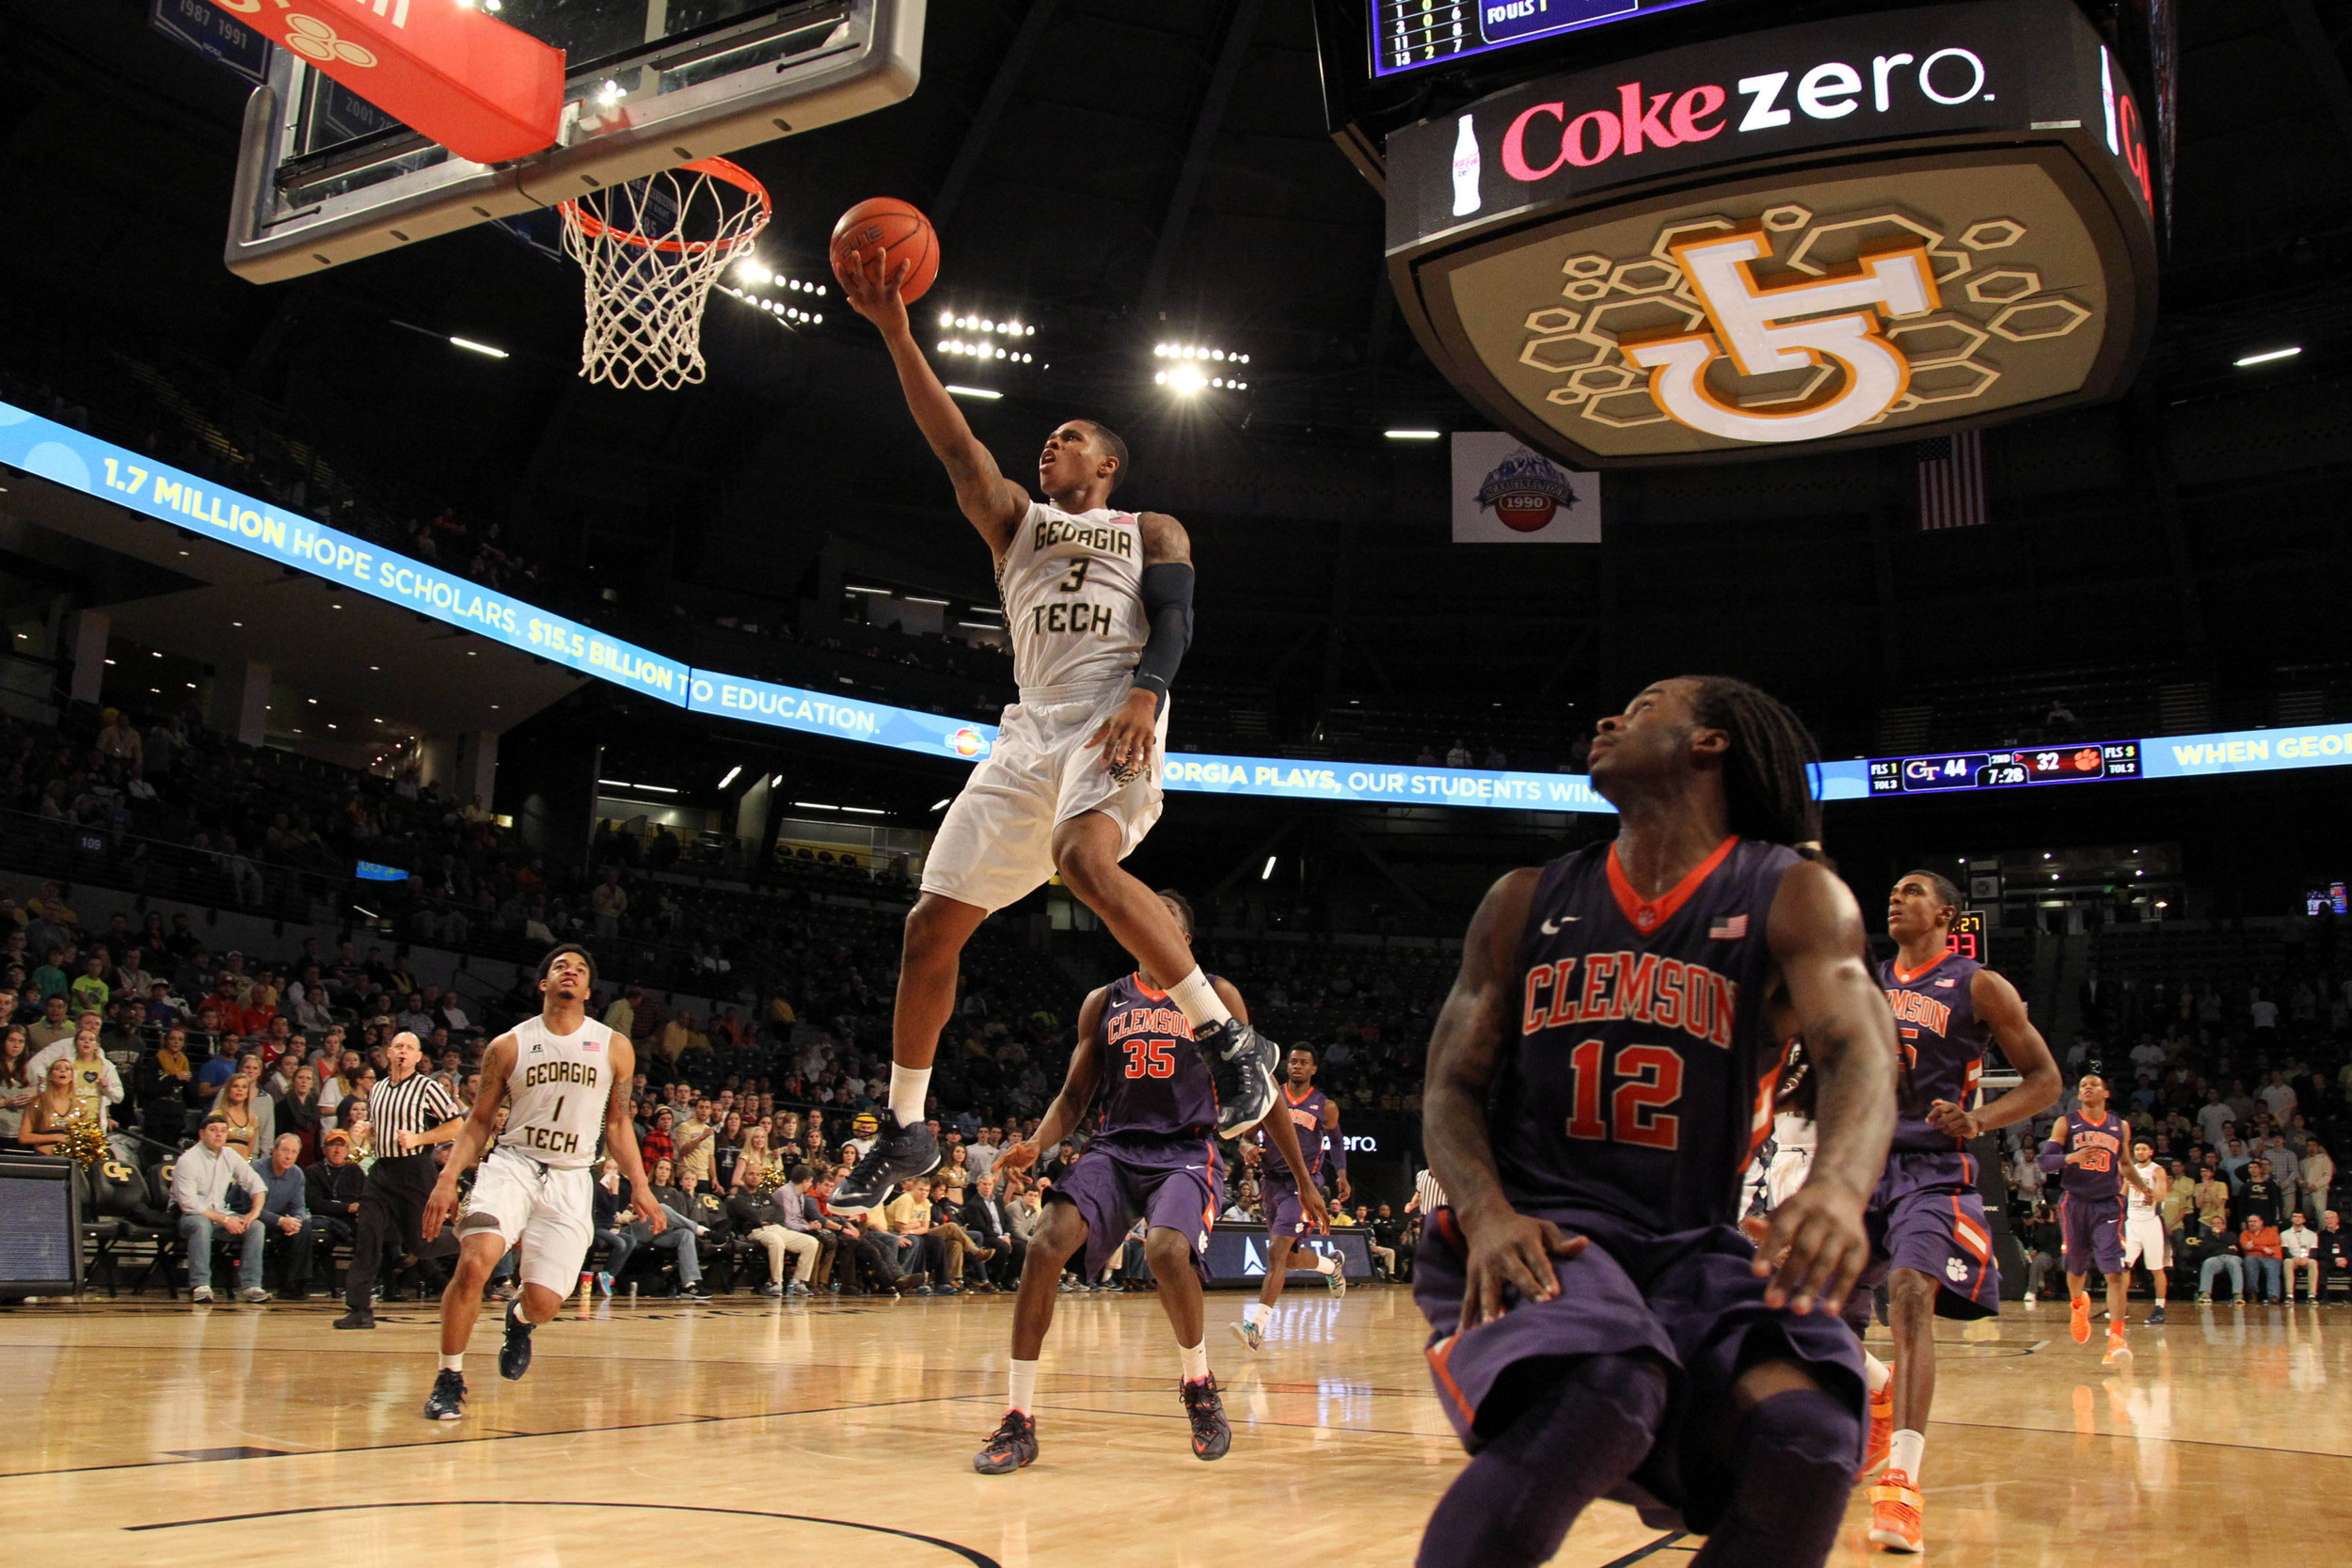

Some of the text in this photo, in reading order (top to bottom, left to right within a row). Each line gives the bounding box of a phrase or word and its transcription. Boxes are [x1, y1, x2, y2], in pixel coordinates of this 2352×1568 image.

[1395, 20, 1406, 35] 3
[1451, 6, 1462, 21] 6
[1486, 0, 1535, 24] FOULS
[217, 19, 247, 49] 1991
[1394, 35, 1409, 51] 11
[1452, 22, 1464, 37] 8
[1394, 38, 1463, 67] 13 2 7
[1502, 81, 1726, 182] Coke
[1737, 47, 1985, 133] zero
[1506, 498, 1544, 508] 1990
[1034, 520, 1133, 560] GEORGIA
[1059, 557, 1089, 594] 3
[104, 458, 881, 734] 1.7 MILLION HOPE SCHOLARS. $15.5 BILLION TO EDUCATION.
[1033, 603, 1112, 636] TECH
[1906, 752, 2059, 781] GT 44 2ND 32
[2105, 747, 2123, 758] FLS
[2171, 740, 2269, 766] WHEN
[1163, 761, 1248, 785] ORGIA
[1255, 767, 1342, 793] PLAYS,
[1348, 771, 1403, 793] OUR
[1411, 776, 1541, 800] STUDENTS
[1870, 763, 1898, 775] FLS 1
[1988, 768, 2025, 785] 7:28
[81, 836, 102, 850] 109
[1952, 916, 1980, 933] :27
[1522, 950, 1739, 1051] CLEMSON
[1884, 989, 1951, 1038] MSON
[1108, 1007, 1196, 1046] CLEMSON
[1122, 1038, 1177, 1079] 35
[526, 1061, 597, 1088] GEORGIA
[551, 1095, 564, 1122] 1
[1565, 1038, 1684, 1150] 12
[524, 1126, 579, 1154] TECH
[103, 1161, 134, 1182] GT
[161, 1164, 177, 1181] G
